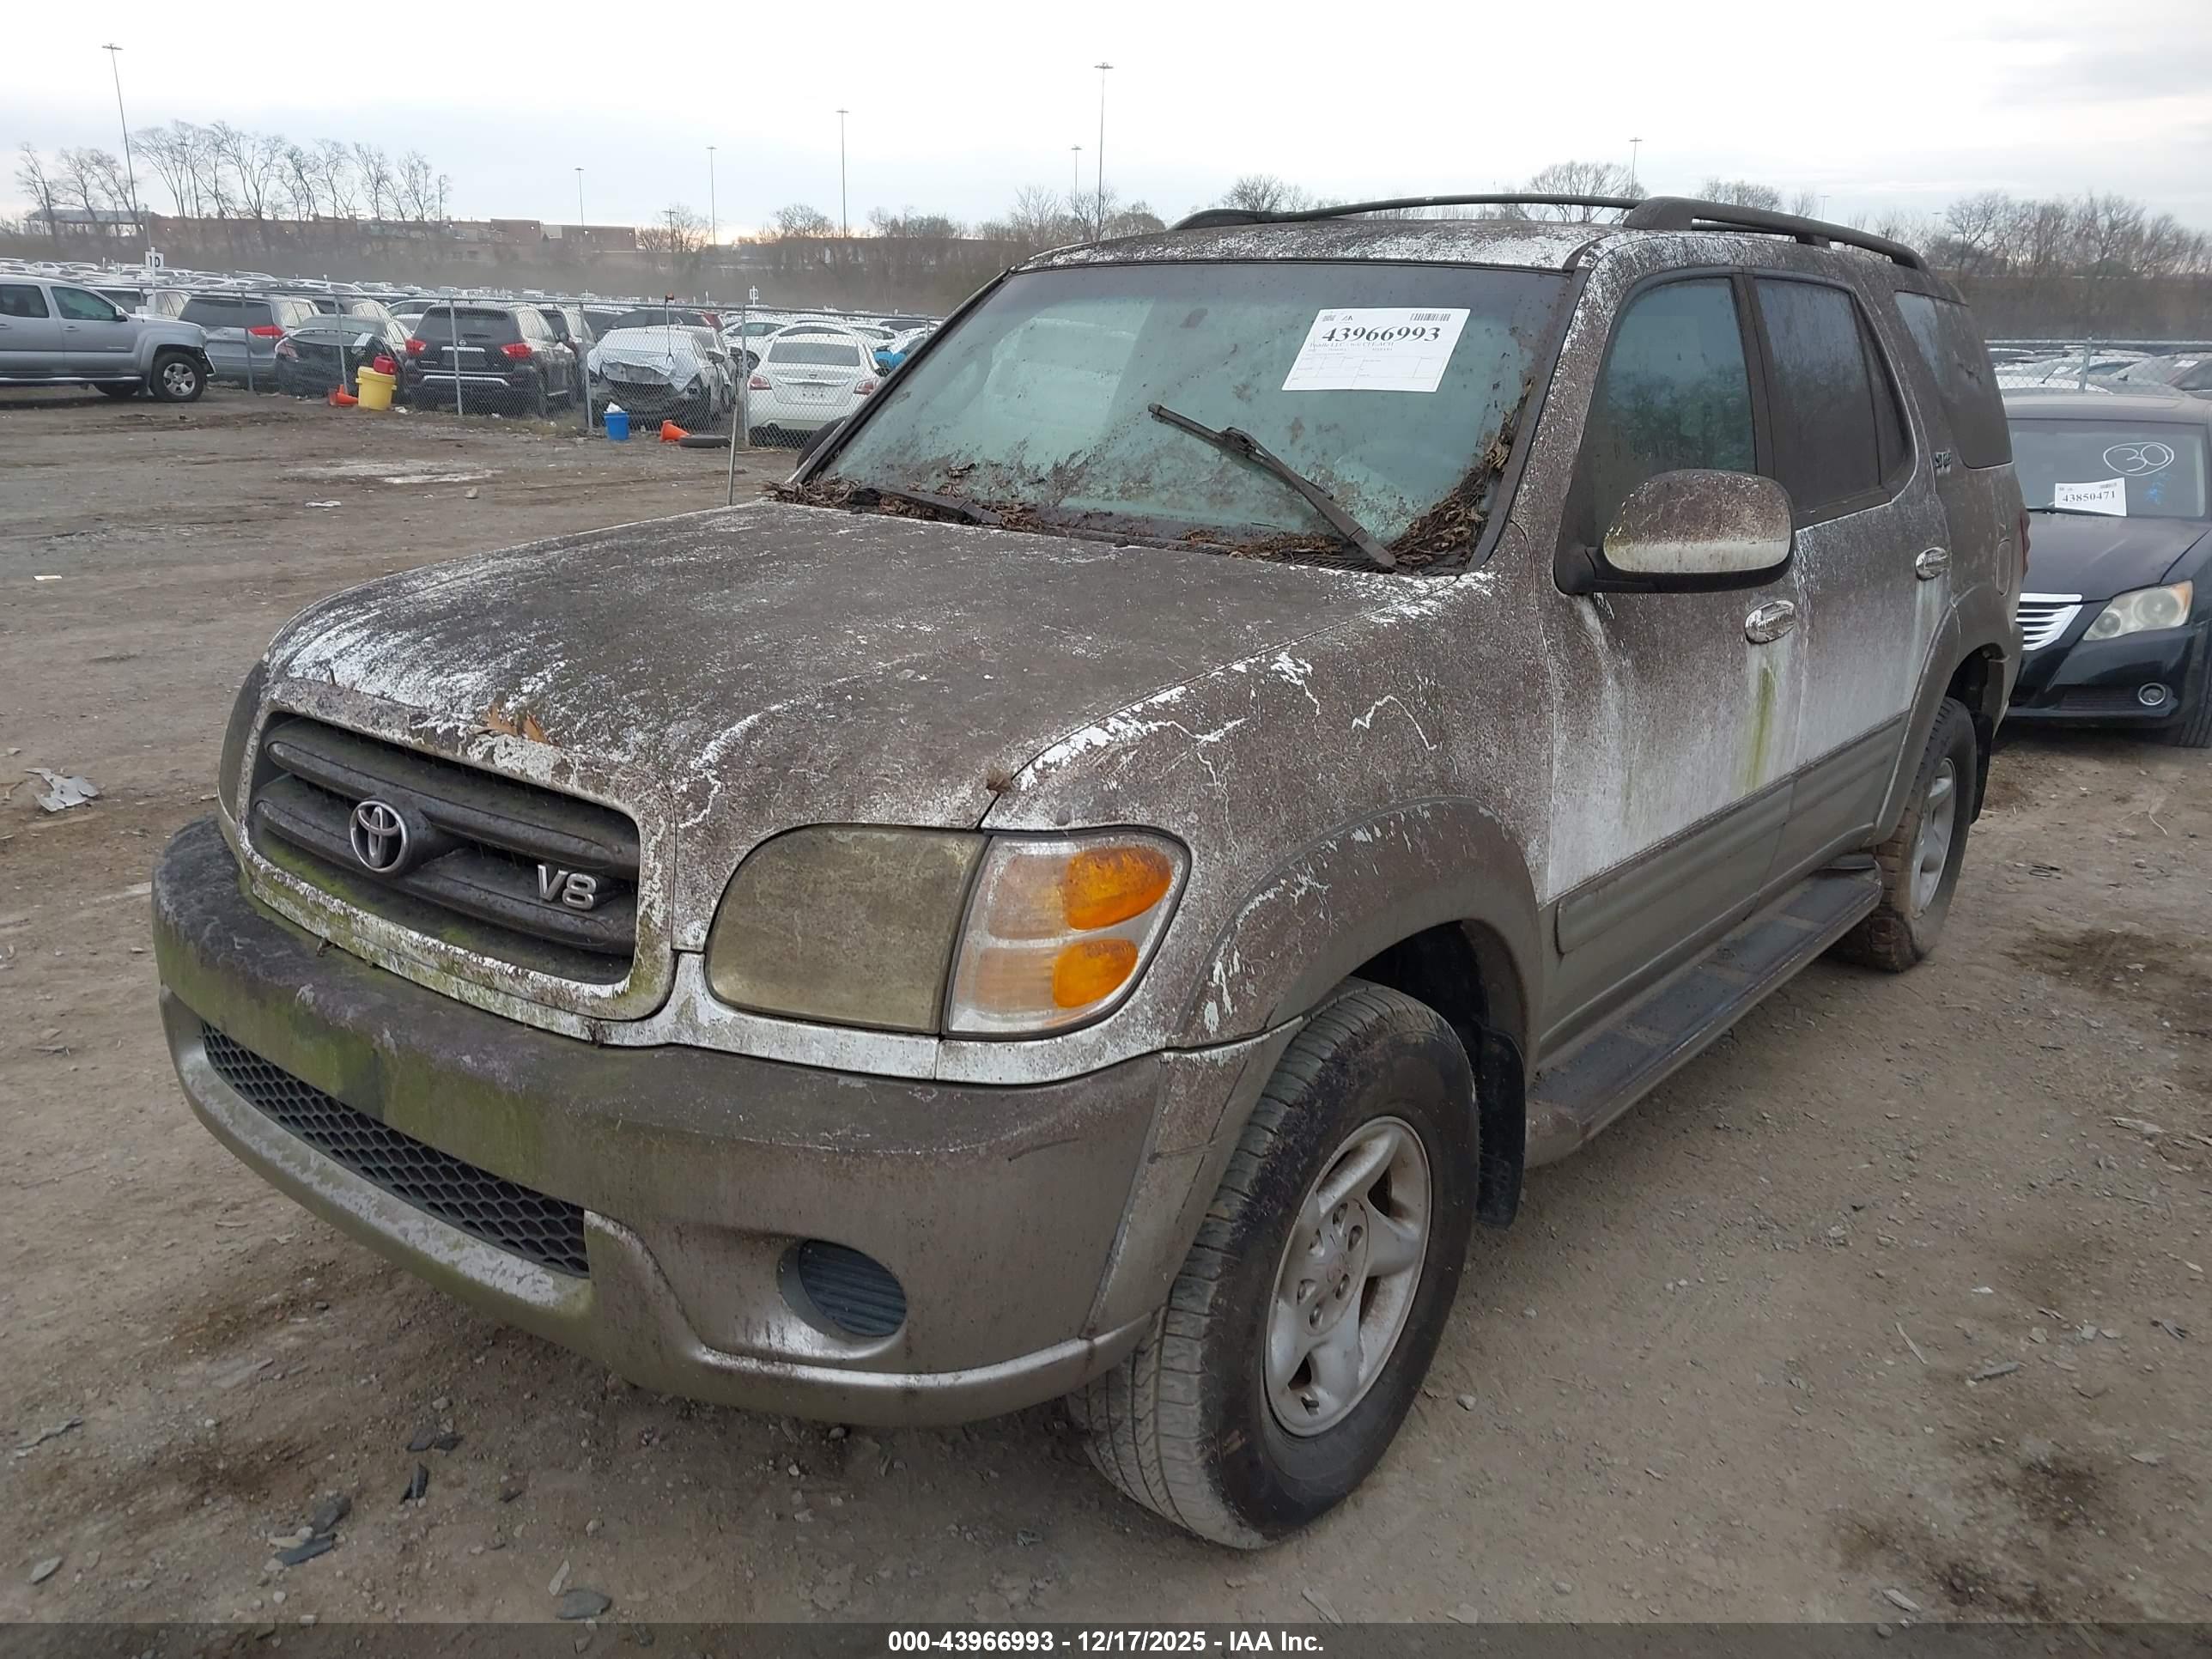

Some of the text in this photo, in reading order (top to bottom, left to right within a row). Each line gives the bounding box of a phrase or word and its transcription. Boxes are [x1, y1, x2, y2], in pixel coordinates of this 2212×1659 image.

[149, 255, 161, 268] 10
[1321, 326, 1441, 342] 43966993
[2112, 444, 2169, 473] 30
[2062, 490, 2115, 502] 43850471
[537, 864, 598, 910] V8
